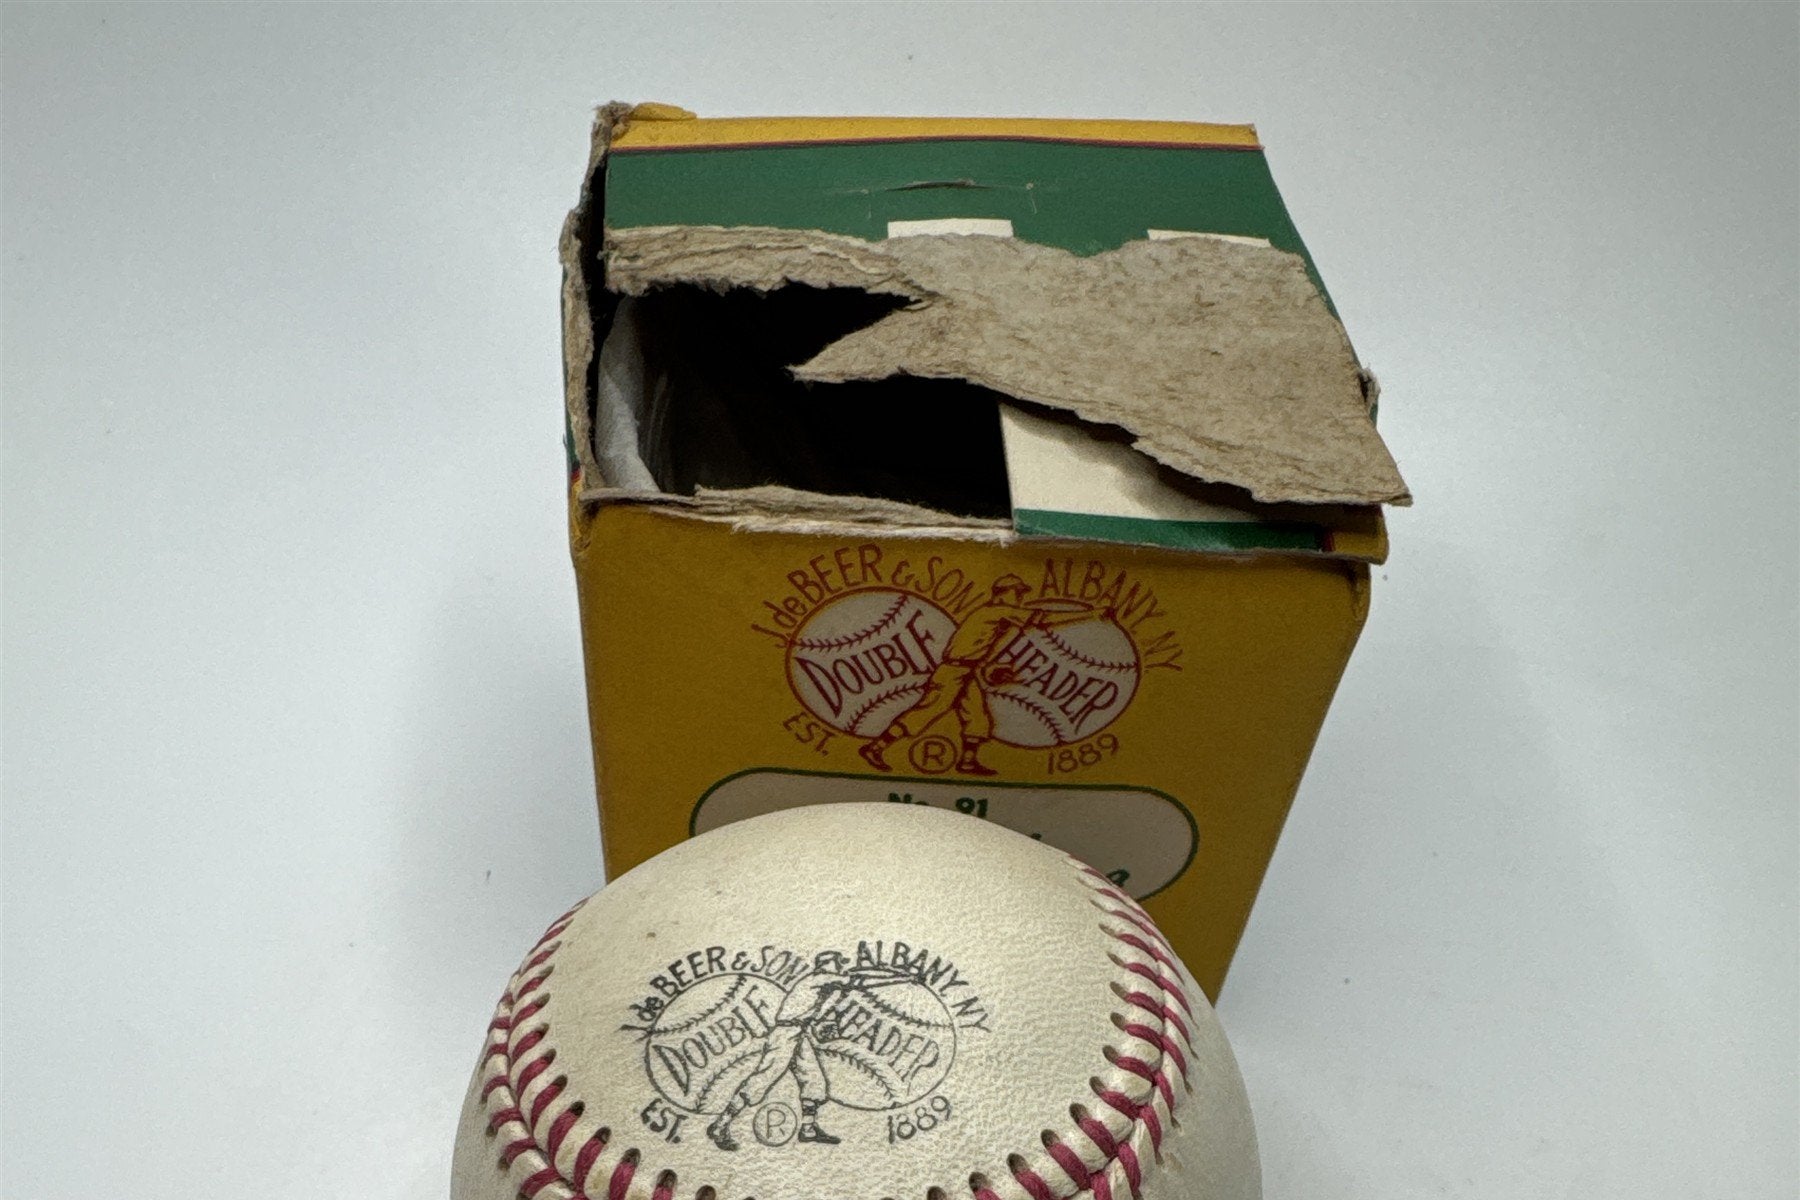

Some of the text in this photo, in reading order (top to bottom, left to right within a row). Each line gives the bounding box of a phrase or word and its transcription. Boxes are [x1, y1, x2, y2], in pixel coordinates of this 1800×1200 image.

[891, 560, 916, 587] &
[914, 556, 986, 615] SON
[794, 609, 1119, 735] DOUBLE HEADER
[783, 712, 836, 756] EST.
[1047, 733, 1119, 775] 1889
[731, 951, 751, 971] &
[750, 945, 810, 985] SON
[651, 984, 940, 1097] DOUBLE HEADER
[641, 1098, 688, 1144] EST.
[887, 1095, 951, 1145] 1889
